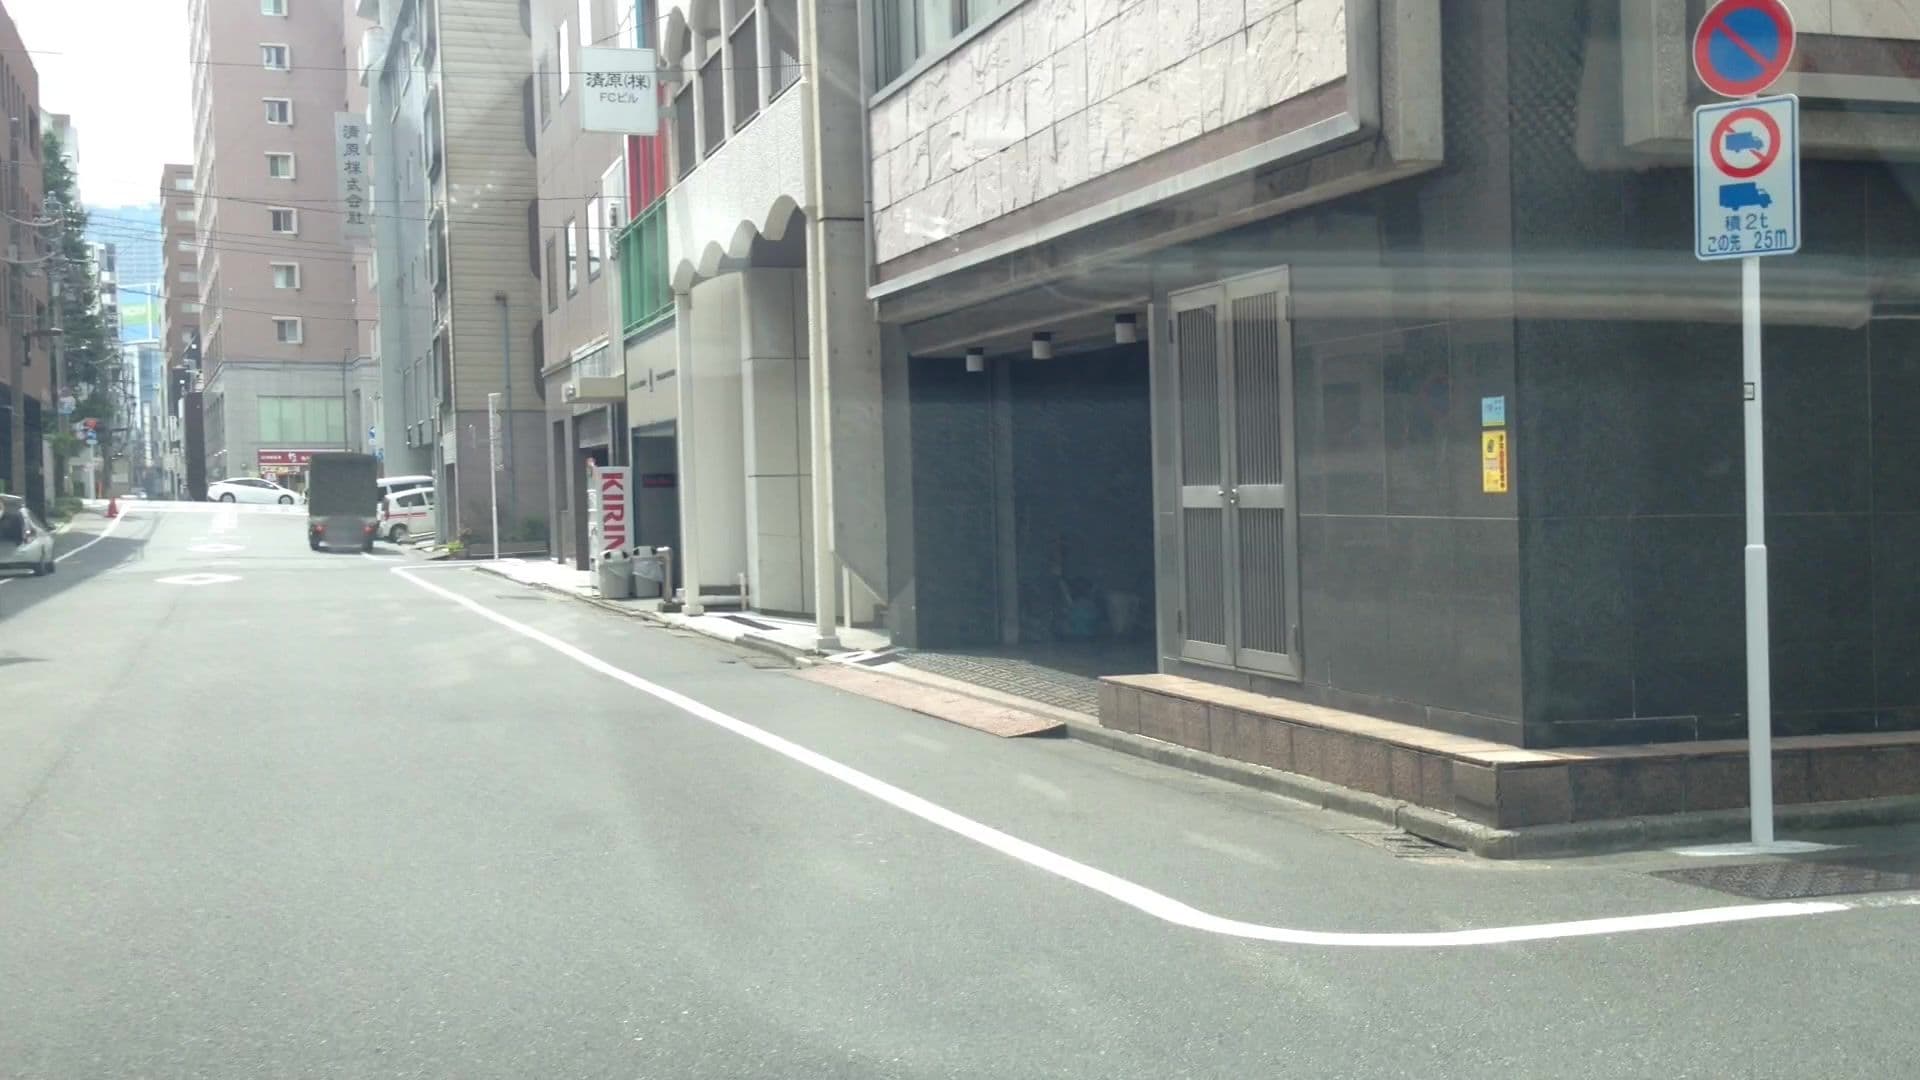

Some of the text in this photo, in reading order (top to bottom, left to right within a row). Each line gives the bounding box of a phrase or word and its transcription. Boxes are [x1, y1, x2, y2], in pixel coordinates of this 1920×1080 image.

[599, 92, 640, 104] FCビル
[1754, 228, 1787, 249] 25m
[601, 472, 626, 552] KIRIN
